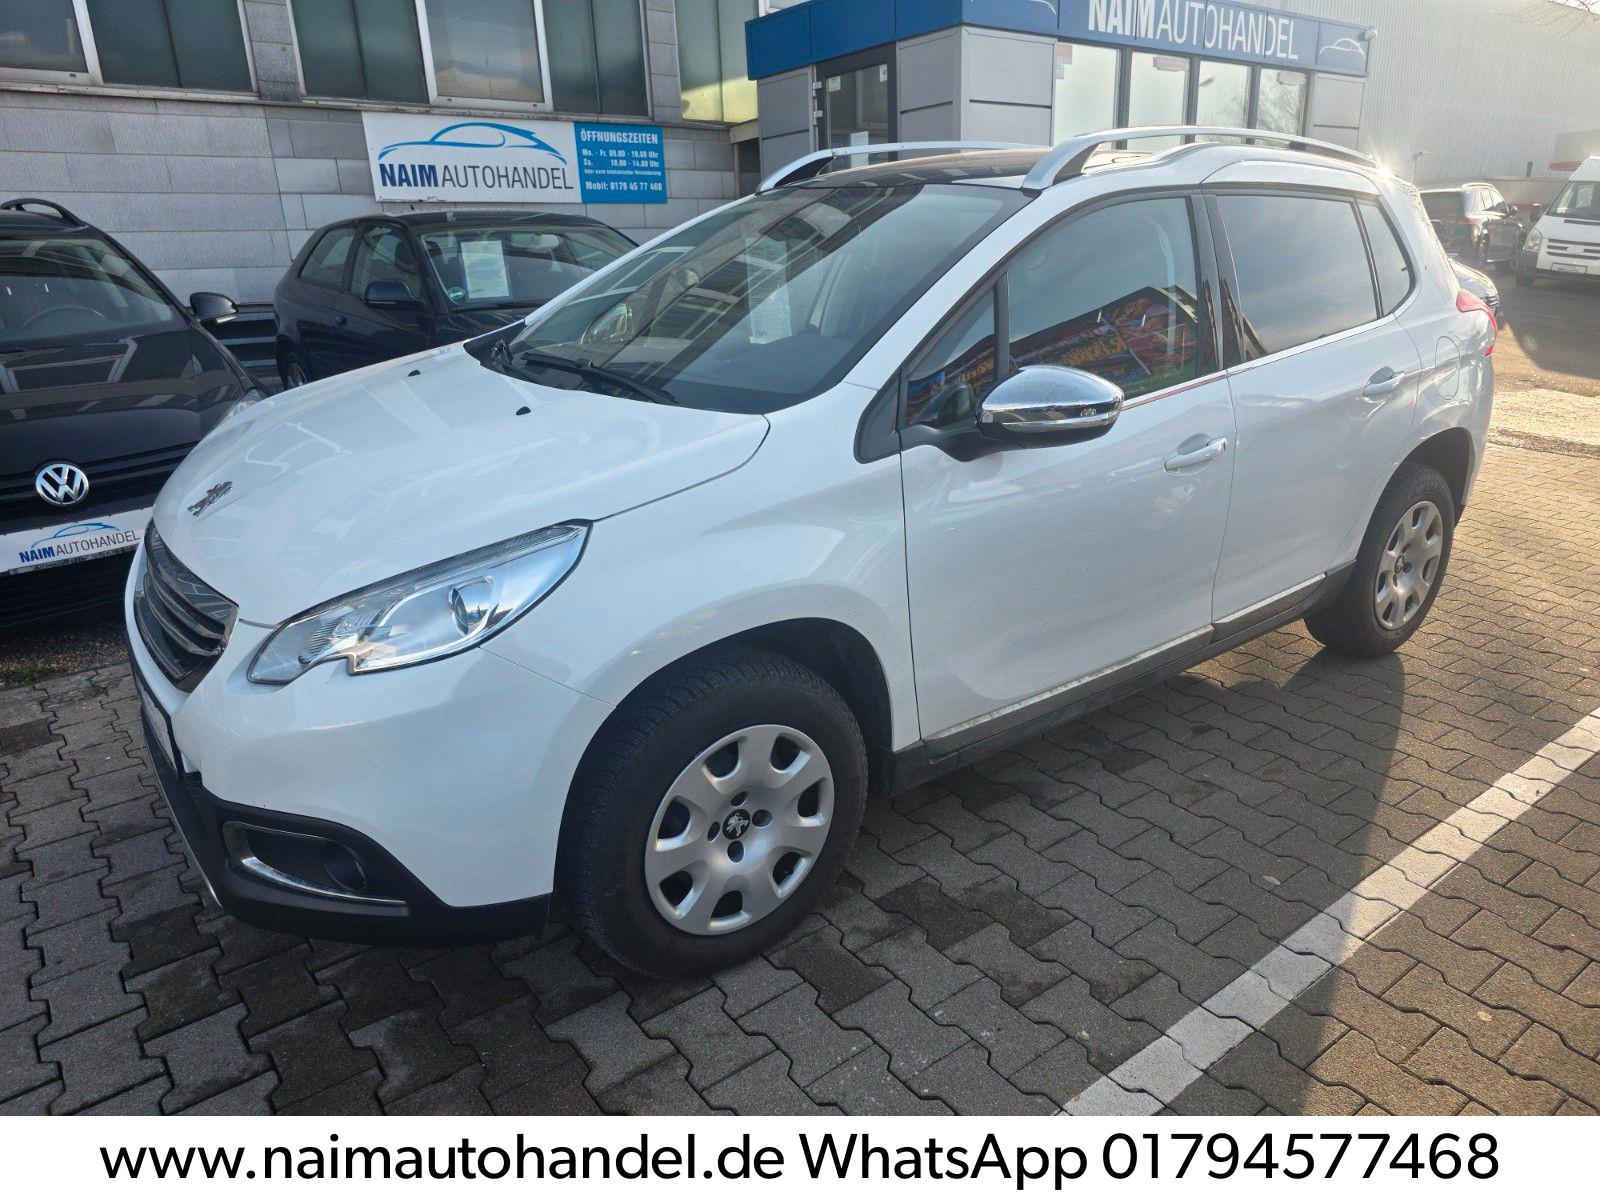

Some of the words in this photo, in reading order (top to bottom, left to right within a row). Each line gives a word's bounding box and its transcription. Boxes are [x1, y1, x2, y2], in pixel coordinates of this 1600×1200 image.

[1088, 0, 1154, 39] NAIM
[1155, 0, 1299, 60] AUTOHANDEL
[580, 129, 659, 144] ÖFFNUNGSZEITEN
[648, 151, 659, 159] Uhr
[649, 160, 660, 168] Uhr
[379, 163, 439, 188] NAIM
[441, 165, 575, 190] AUTOHANDEL
[585, 181, 609, 190] Mobil:
[610, 182, 628, 191] 0179
[629, 182, 638, 191] 45
[639, 182, 648, 191] 77
[19, 546, 56, 563] NAIM
[56, 530, 140, 556] AUTOHANDEL
